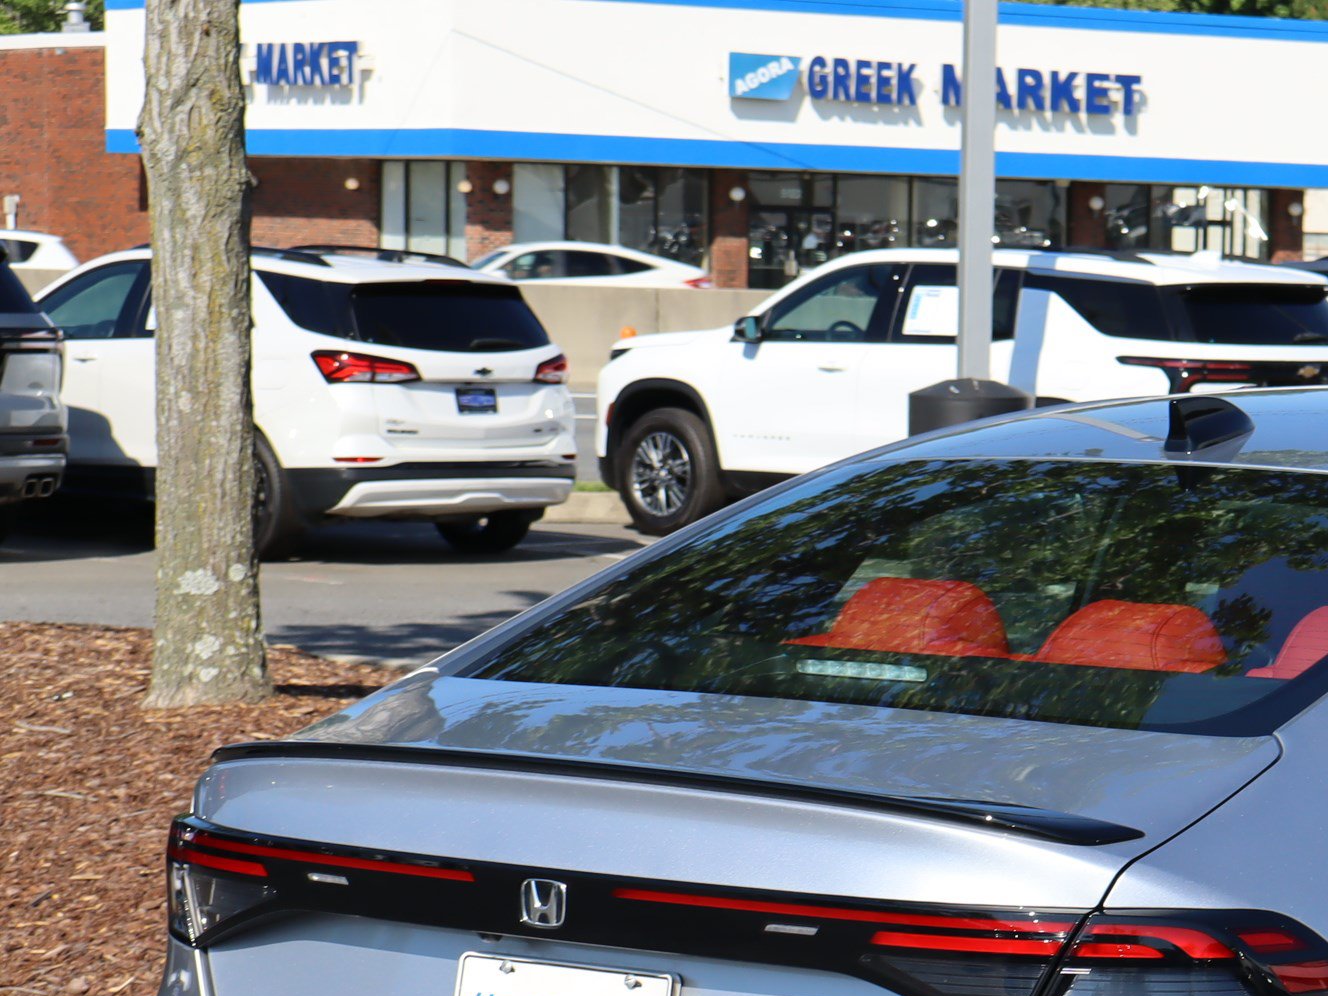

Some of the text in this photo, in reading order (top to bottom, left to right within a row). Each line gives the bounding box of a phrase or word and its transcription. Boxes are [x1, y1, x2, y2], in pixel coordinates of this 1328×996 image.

[256, 41, 358, 85] MARKET
[734, 56, 795, 96] AGORA
[808, 56, 917, 106] GREEK
